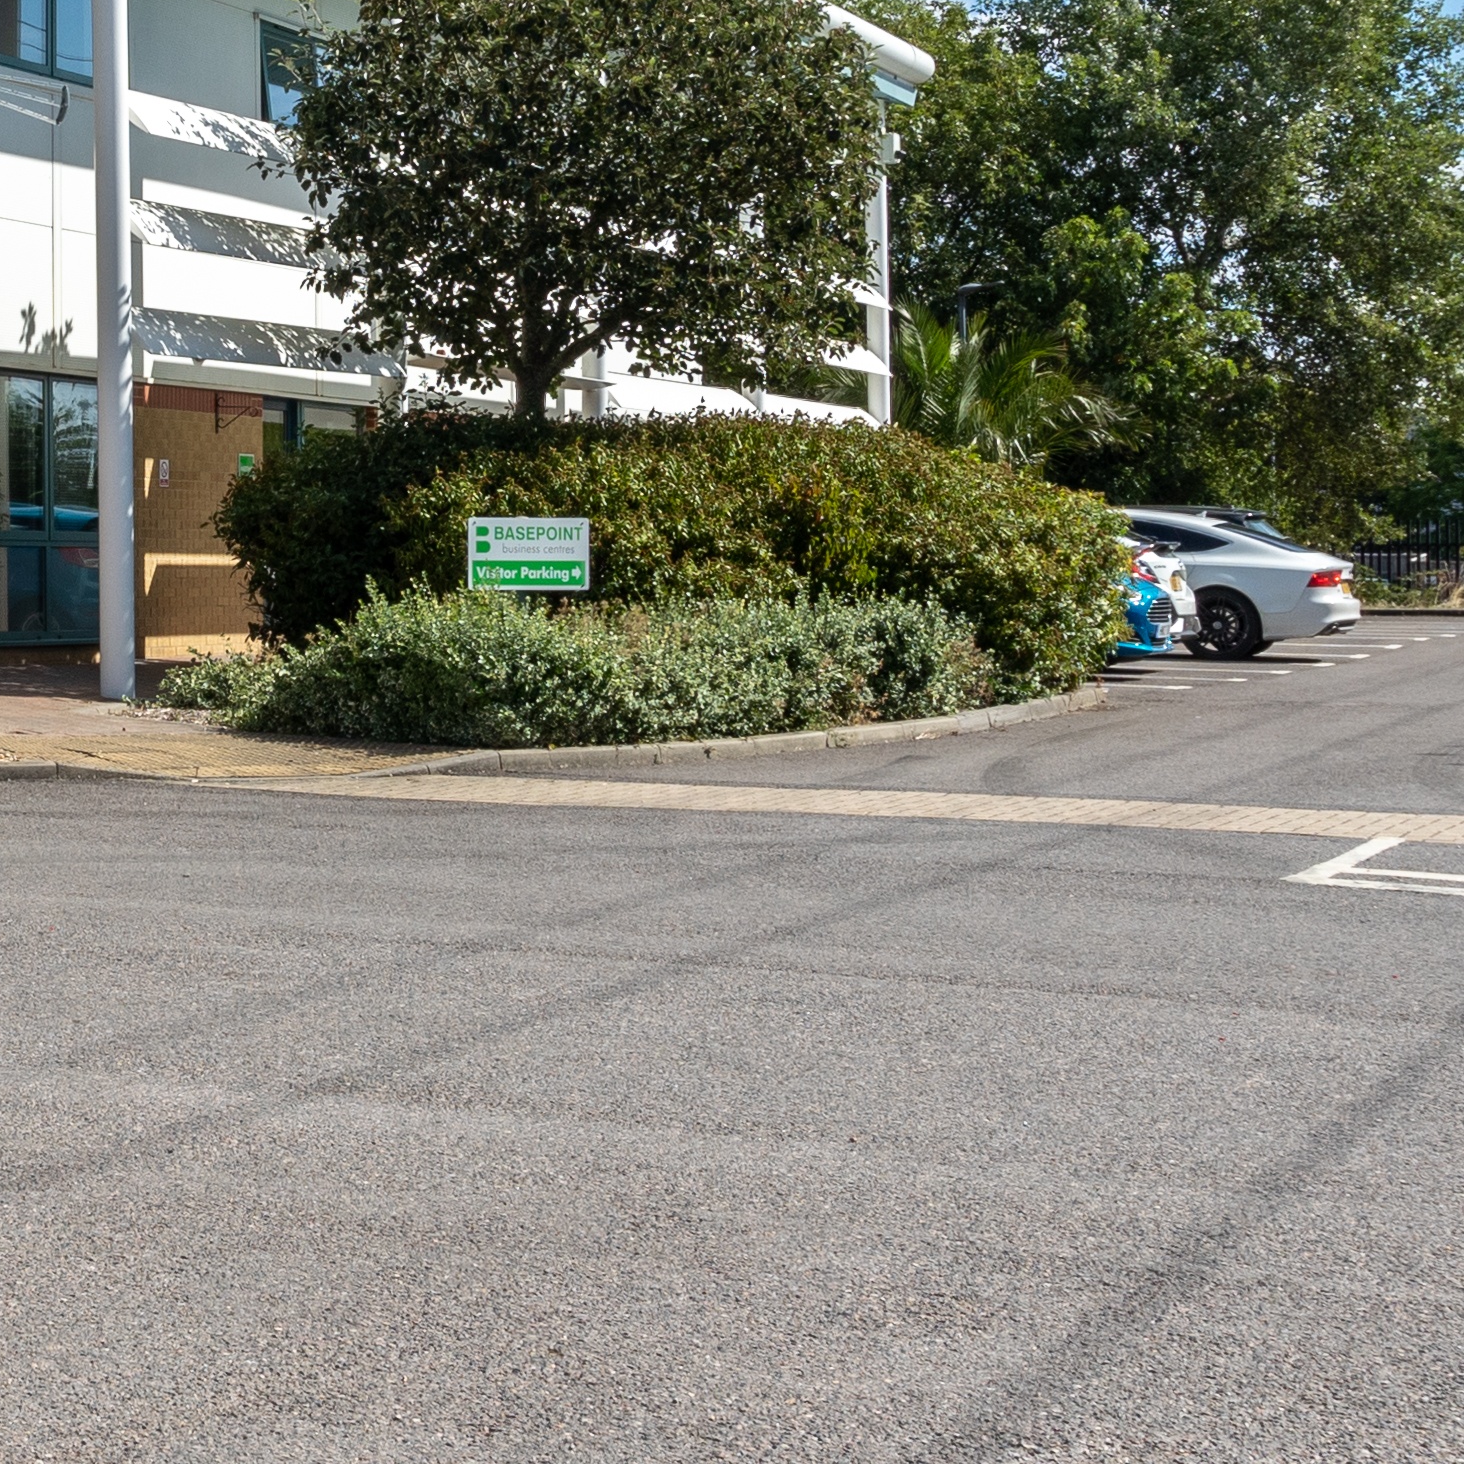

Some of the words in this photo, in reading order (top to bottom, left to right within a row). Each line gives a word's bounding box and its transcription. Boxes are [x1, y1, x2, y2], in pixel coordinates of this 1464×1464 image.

[494, 526, 583, 541] BASEPOINT
[502, 543, 540, 554] business
[543, 544, 575, 554] centres
[476, 566, 518, 579] Visitor
[521, 566, 570, 583] Parking
